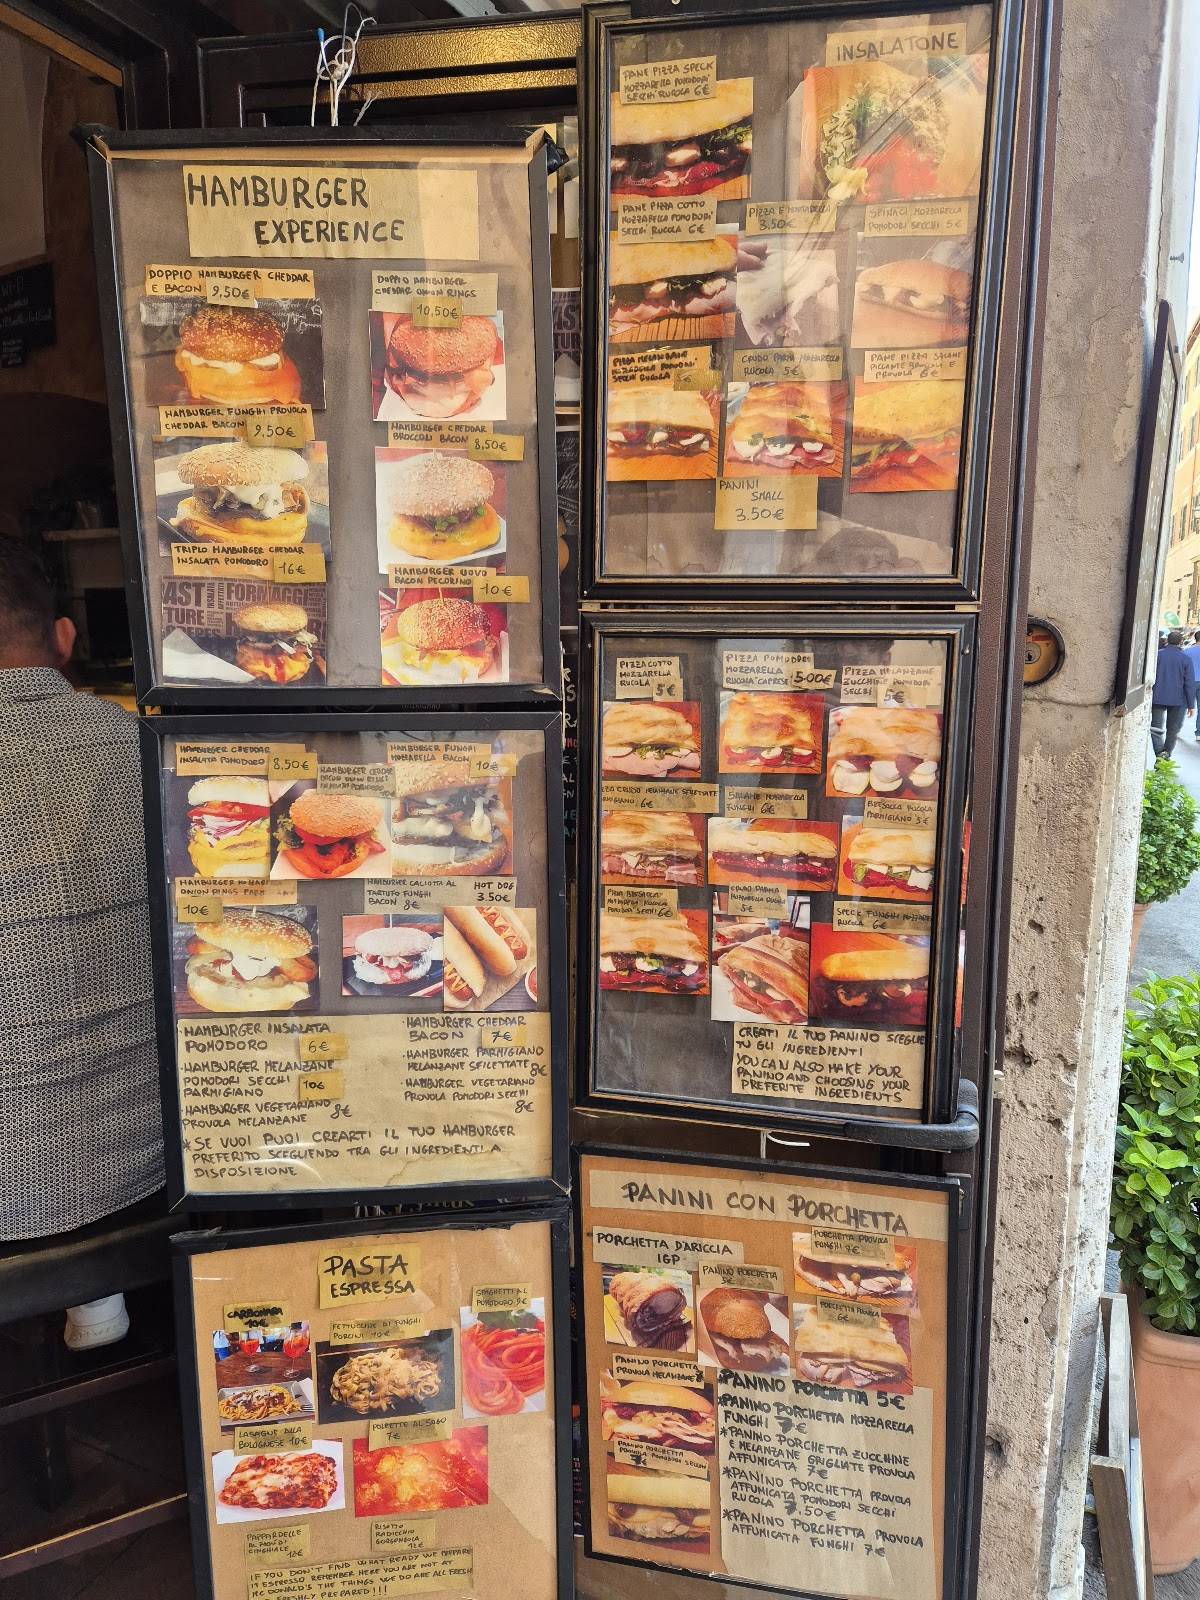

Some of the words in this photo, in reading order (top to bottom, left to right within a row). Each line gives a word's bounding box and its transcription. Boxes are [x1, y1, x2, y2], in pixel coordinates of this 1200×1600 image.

[836, 32, 959, 61] INSALATONE
[187, 172, 369, 209] HAMBURGER
[254, 219, 405, 245] EXPERIENCE
[149, 268, 193, 281] DOPPIO
[199, 270, 262, 281] HAMBURGER
[267, 271, 311, 283] CHEDDAR
[152, 284, 159, 293] E
[164, 284, 202, 293] BACON
[446, 289, 478, 298] RINGS
[165, 409, 224, 418] HAMBURGER
[227, 407, 265, 416] FUNGHI
[165, 420, 208, 430] CHEDDAR
[212, 420, 246, 429] BACON
[439, 434, 469, 443] BACON
[719, 479, 760, 490] PANINI
[751, 490, 785, 501] SMALL
[735, 507, 785, 522] 3.50€
[174, 546, 208, 554] TRIPLO
[177, 556, 220, 565] INSALATA
[279, 561, 307, 574] 16€
[460, 569, 488, 577] UOVO
[395, 576, 424, 585] BACON
[428, 576, 472, 585] PECORINO
[480, 583, 513, 597] 10€
[619, 670, 672, 679] MOZZARELLA
[726, 665, 784, 675] MOZZARELLA
[619, 679, 651, 687] RUCOLA
[473, 881, 493, 890] HOT
[497, 880, 514, 890] DOG
[403, 890, 432, 898] FUNGHI
[369, 897, 398, 906] BACON
[183, 904, 209, 916] 10€
[406, 1017, 472, 1029] HAMBURGER
[477, 1016, 527, 1027] CHEDDAR
[184, 1023, 262, 1037] HAMBURGER
[267, 1023, 331, 1034] INSALATA
[409, 1031, 464, 1042] BACON
[491, 1031, 513, 1043] 7€
[738, 1027, 779, 1039] CREATI
[787, 1027, 799, 1039] IL
[804, 1030, 826, 1041] TUO
[830, 1030, 881, 1042] PANINO
[185, 1039, 268, 1053] POMODORO
[308, 1040, 330, 1053] 6€
[736, 1040, 752, 1049] TU
[757, 1041, 774, 1051] GLI
[782, 1043, 863, 1057] INGREDIENTI
[406, 1048, 469, 1060] HAMBURGER
[476, 1047, 545, 1058] PARMIGIANO
[183, 1060, 260, 1073] HAMBURGER
[264, 1060, 335, 1073] MELANZANE
[737, 1053, 760, 1066] YOU
[761, 1058, 789, 1071] CAN
[793, 1060, 825, 1073] ALSO
[829, 1062, 862, 1075] MAKE
[868, 1065, 905, 1079] YOUR
[183, 1076, 240, 1086] POMODORI
[248, 1075, 290, 1087] SECCHI
[406, 1078, 465, 1088] HAMBURGER
[471, 1078, 535, 1087] VEGETARIANO
[737, 1067, 785, 1081] PANINO
[786, 1073, 811, 1083] AND
[816, 1076, 874, 1090] CHOOSING
[882, 1080, 911, 1092] YOUR
[183, 1088, 264, 1098] PARMIGIANO
[404, 1091, 446, 1101] PROVOLA
[452, 1092, 495, 1101] POMODORI
[741, 1079, 805, 1094] PREFERITE
[814, 1086, 904, 1103] INGREDIENTS
[185, 1102, 250, 1116] HAMBURGER
[255, 1099, 331, 1112] VEGETARIANO
[330, 1103, 352, 1119] 8€
[514, 1100, 535, 1113] 8€
[181, 1117, 231, 1130] PROVOLA
[238, 1114, 307, 1127] MELANZANE
[195, 1137, 213, 1150] SE
[220, 1135, 252, 1148] VUOI
[262, 1132, 299, 1146] PUOI
[312, 1130, 371, 1143] CREARTI
[385, 1128, 399, 1139] IL
[408, 1126, 436, 1138] TUO
[443, 1125, 516, 1138] HAMBURGER
[192, 1151, 261, 1164] PREFERITO
[346, 1146, 370, 1156] TRA
[380, 1146, 398, 1156] GLI
[405, 1144, 483, 1155] INGREDIENTI
[490, 1144, 501, 1153] A
[193, 1167, 298, 1179] DISPOSIZIONE
[620, 1181, 714, 1211] PANINI
[726, 1191, 776, 1214] CON
[787, 1194, 910, 1236] PORCHETTA
[596, 1232, 669, 1250] PORCHETTA
[675, 1241, 733, 1256] D'ARICCIA
[322, 1253, 409, 1278] PASTA
[657, 1253, 681, 1265] IGP
[330, 1280, 416, 1298] ESPRESSA
[722, 1369, 786, 1393] PANINO
[791, 1379, 870, 1407] PORCHETTA
[877, 1390, 906, 1411] 5€
[722, 1393, 772, 1414] PANINO
[772, 1402, 845, 1425] PORCHETTA
[850, 1414, 915, 1435] MOZZARELLA
[724, 1409, 769, 1429] FUNGHI
[728, 1426, 772, 1443] PANINO
[777, 1434, 848, 1457] PORCHETTA
[852, 1451, 910, 1467] ZUCCHINE
[729, 1451, 798, 1473] AFFUMICATA
[807, 1465, 828, 1480] 7€
[730, 1440, 735, 1448] E
[738, 1440, 801, 1460] MELANZANE
[807, 1455, 865, 1473] GRIGLIATE
[868, 1463, 916, 1481] PROVOLA
[732, 1467, 784, 1489] PANINO
[789, 1478, 863, 1501] PORCHETTA
[870, 1490, 911, 1507] PROVOLA
[730, 1480, 796, 1501] AFFUMICATA
[801, 1494, 851, 1511] POMODORI
[857, 1503, 897, 1518] SECCHI
[732, 1491, 775, 1509] RUCOLA
[732, 1509, 785, 1528] PANINO
[791, 1518, 866, 1540] PORCHETTA
[875, 1529, 924, 1549] PROVOLA
[732, 1524, 801, 1546] AFFUMICATA
[810, 1537, 854, 1552] FUNGHI
[863, 1543, 885, 1557] 7€
[251, 1573, 261, 1581] IF
[264, 1571, 283, 1579] YOU
[328, 1562, 351, 1571] FIND
[357, 1558, 385, 1566] WHAT
[390, 1554, 420, 1564] READY
[359, 1568, 381, 1577] HERE
[384, 1566, 401, 1574] YOU
[441, 1559, 454, 1567] AT
[318, 1582, 335, 1590] THE
[399, 1574, 413, 1582] DO
[433, 1569, 447, 1578] ALL
